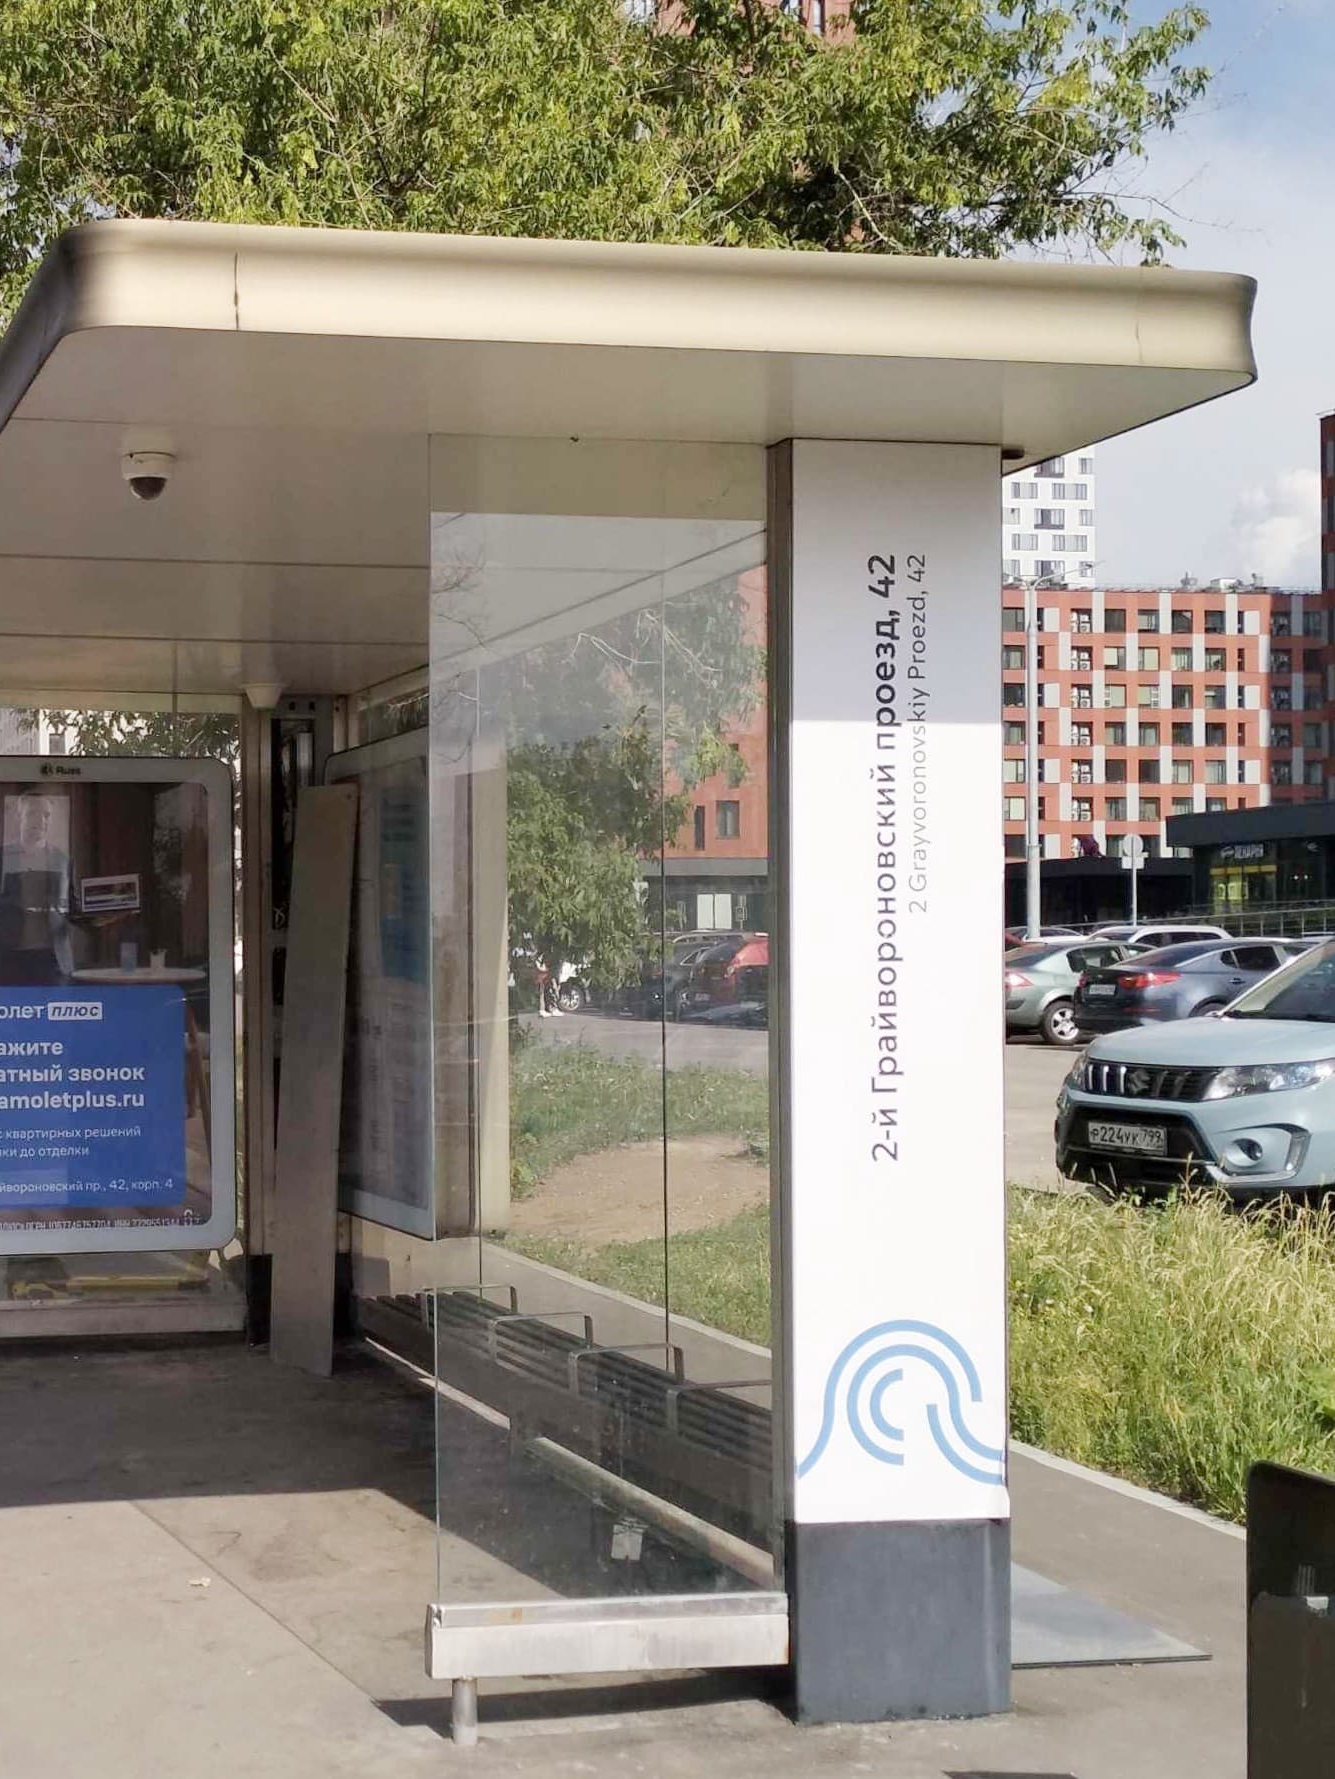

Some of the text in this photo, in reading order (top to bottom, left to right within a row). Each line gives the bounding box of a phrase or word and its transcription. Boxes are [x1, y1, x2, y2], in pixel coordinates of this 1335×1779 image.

[906, 553, 931, 913] 2 Grayvoronovskiy Proezd, 42
[867, 554, 904, 1162] 2-й Грайвороновский проезд, 42
[68, 1066, 146, 1081] звонок
[5, 1128, 82, 1142] квартирных
[84, 1125, 141, 1140] решений
[19, 1147, 36, 1159] до
[37, 1146, 90, 1159] отделки
[164, 1178, 174, 1190] 4
